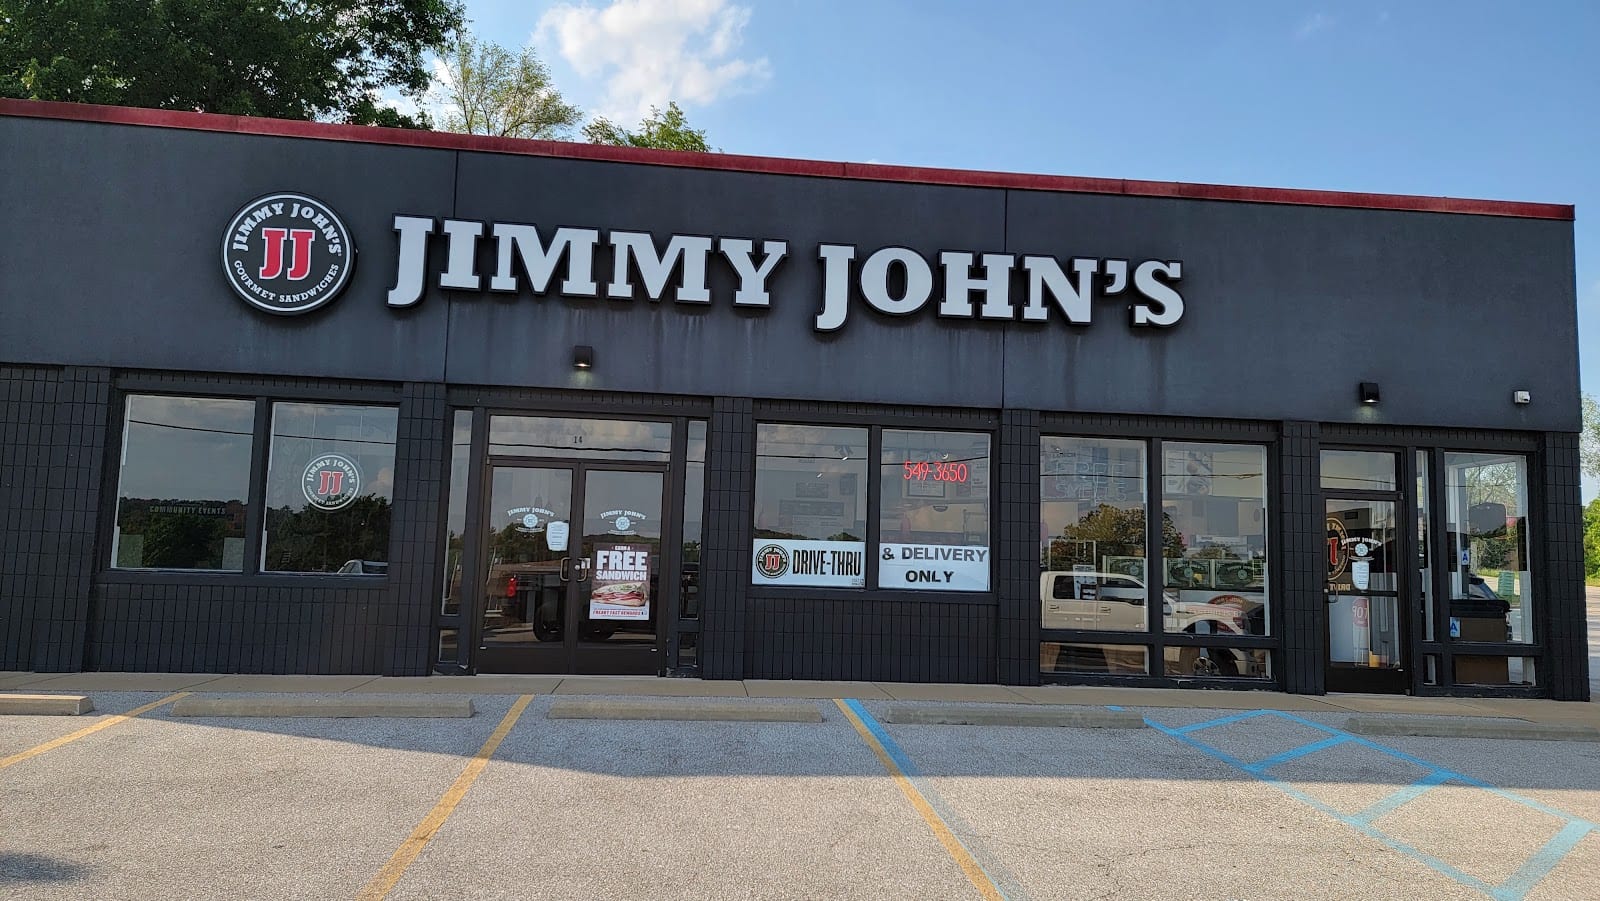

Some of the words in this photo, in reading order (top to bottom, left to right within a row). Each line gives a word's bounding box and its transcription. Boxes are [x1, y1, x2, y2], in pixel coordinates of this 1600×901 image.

[232, 202, 284, 252] JIMMY
[290, 203, 342, 256] JOHN'S
[259, 227, 316, 281] JJ
[234, 260, 276, 301] GOURMET
[279, 263, 340, 303] SANDWICHES
[387, 214, 789, 306] JIMMY
[814, 243, 1186, 331] JOHN'S
[317, 470, 344, 496] JJ
[903, 461, 968, 483] 549-3650
[596, 550, 649, 571] FREE
[765, 554, 781, 571] JJ
[792, 549, 862, 577] DRIVE-THRU
[882, 547, 895, 561] &
[901, 547, 988, 563] DELIVERY
[595, 570, 647, 581] SANDWICH
[905, 569, 955, 584] ONLY
